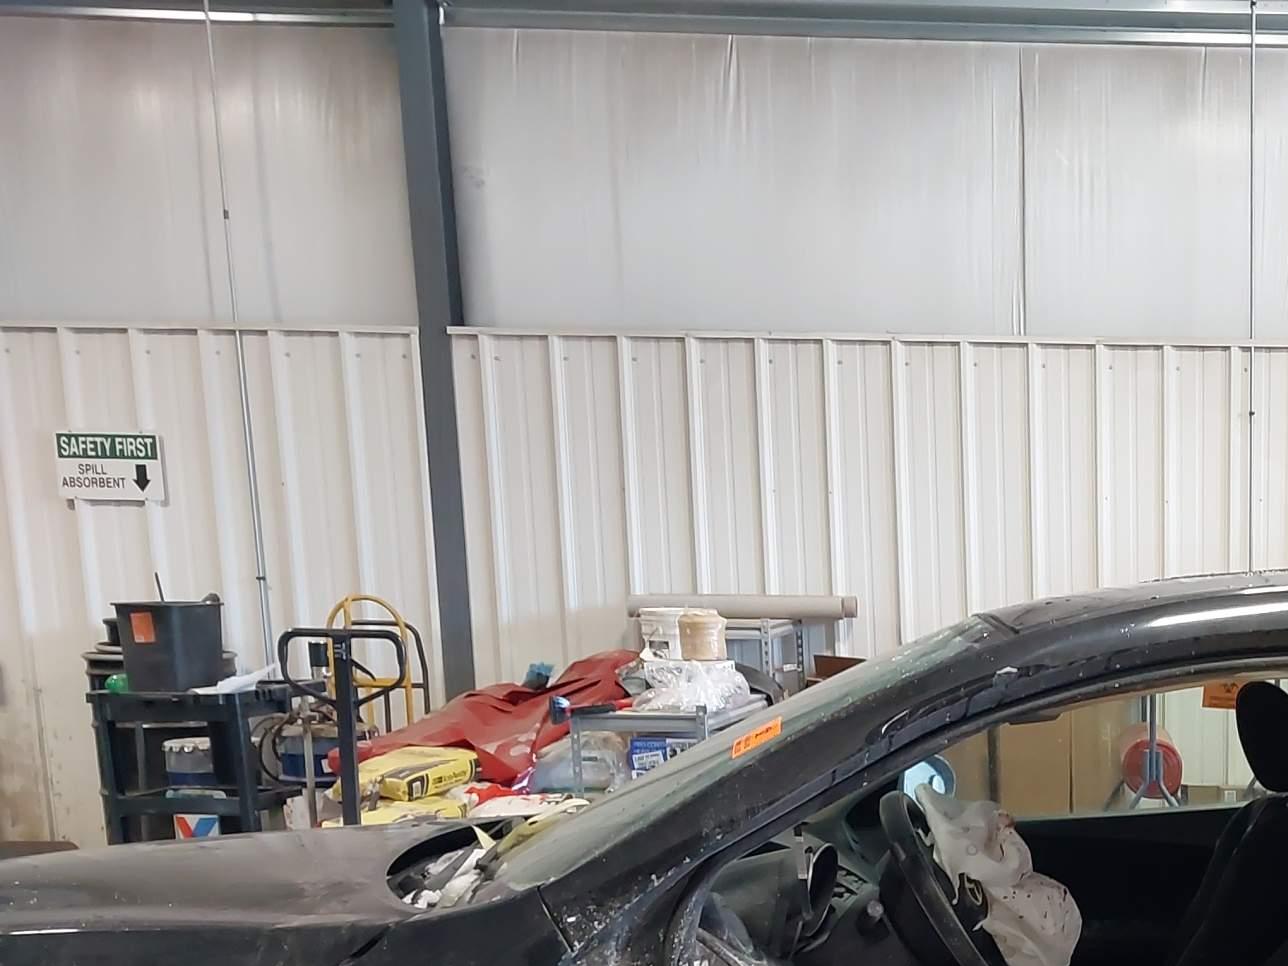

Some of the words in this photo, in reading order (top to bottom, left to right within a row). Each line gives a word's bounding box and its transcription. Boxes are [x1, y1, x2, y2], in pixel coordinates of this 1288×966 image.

[60, 435, 112, 456] SAFETY
[115, 437, 153, 457] FIRST
[78, 463, 107, 475] SPILL
[62, 477, 126, 488] ABSORBENT
